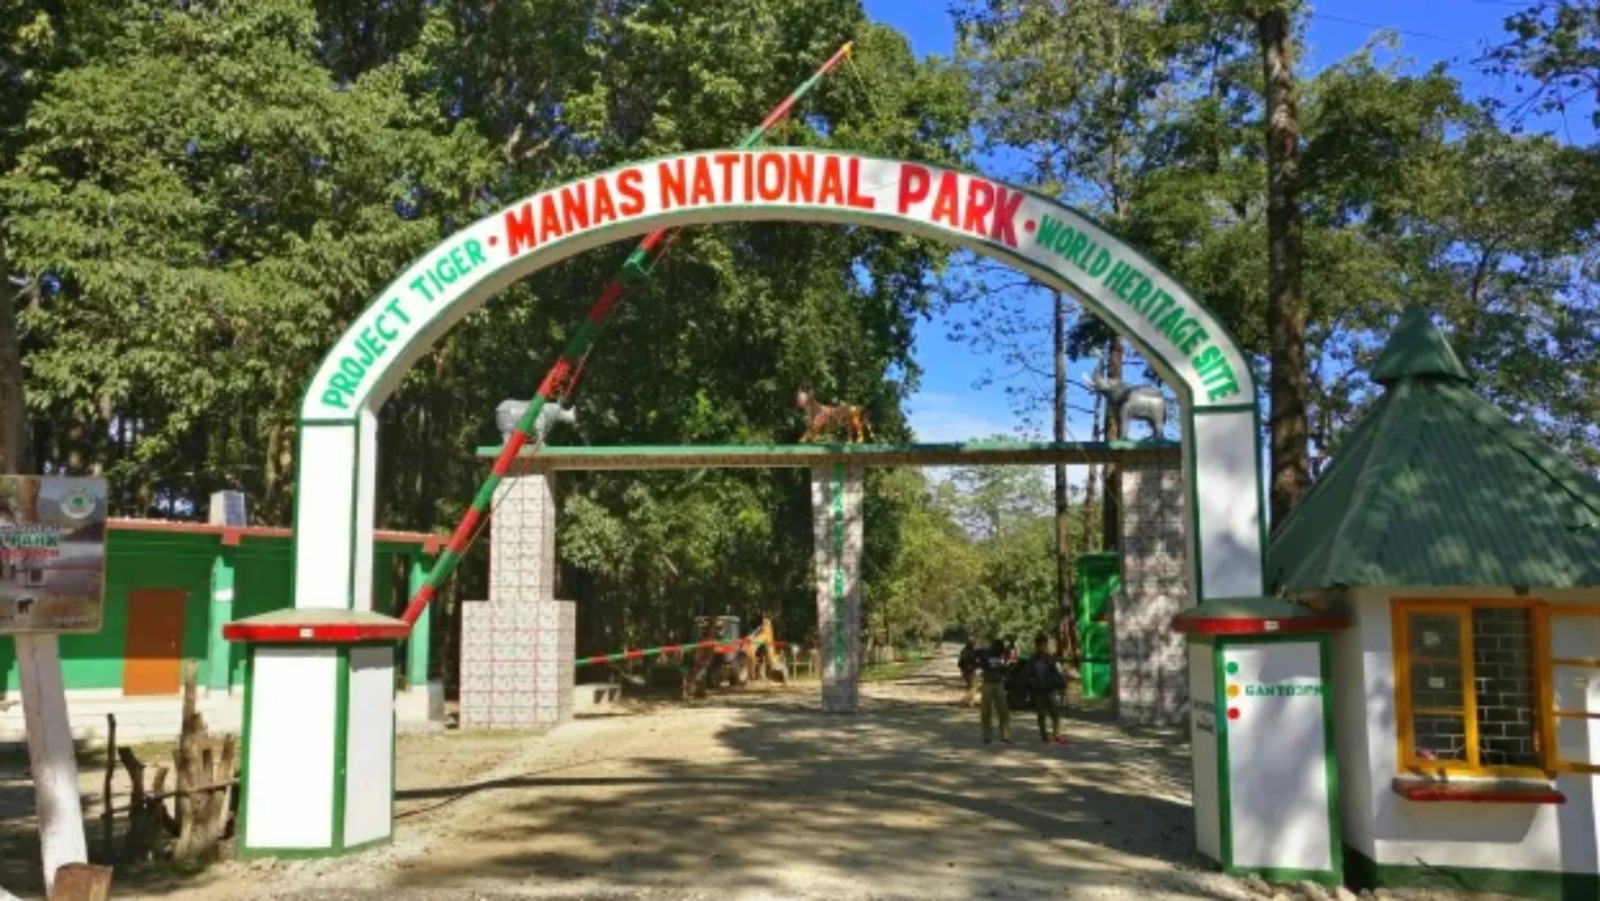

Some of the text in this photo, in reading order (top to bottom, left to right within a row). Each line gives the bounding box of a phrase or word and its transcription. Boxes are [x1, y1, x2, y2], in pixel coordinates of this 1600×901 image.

[321, 152, 1241, 410] PROJECT TIGER MANAS NATIONAL PARK WORLD HERITAGE SITE
